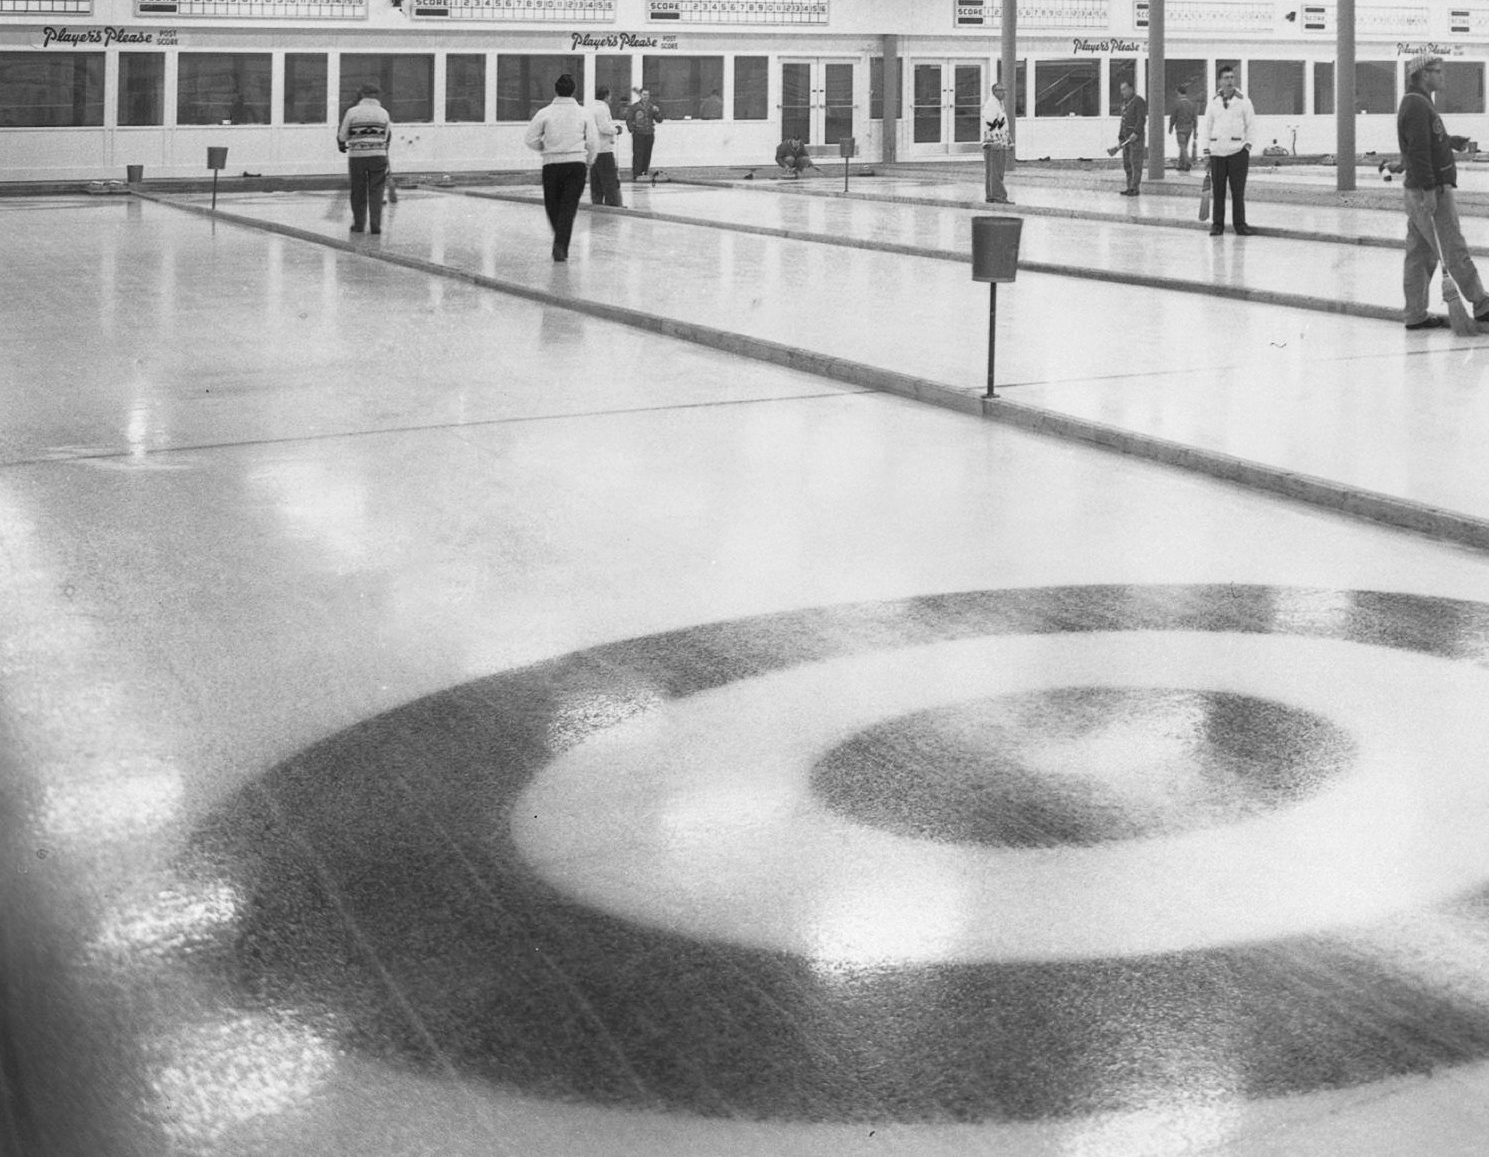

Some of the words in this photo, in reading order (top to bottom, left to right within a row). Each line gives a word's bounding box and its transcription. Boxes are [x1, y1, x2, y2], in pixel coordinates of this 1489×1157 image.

[957, 8, 983, 16] SCORE
[43, 26, 101, 47] Player's
[104, 26, 152, 47] Please
[571, 32, 618, 50] Player's
[619, 32, 658, 50] Please
[1110, 38, 1140, 53] Please
